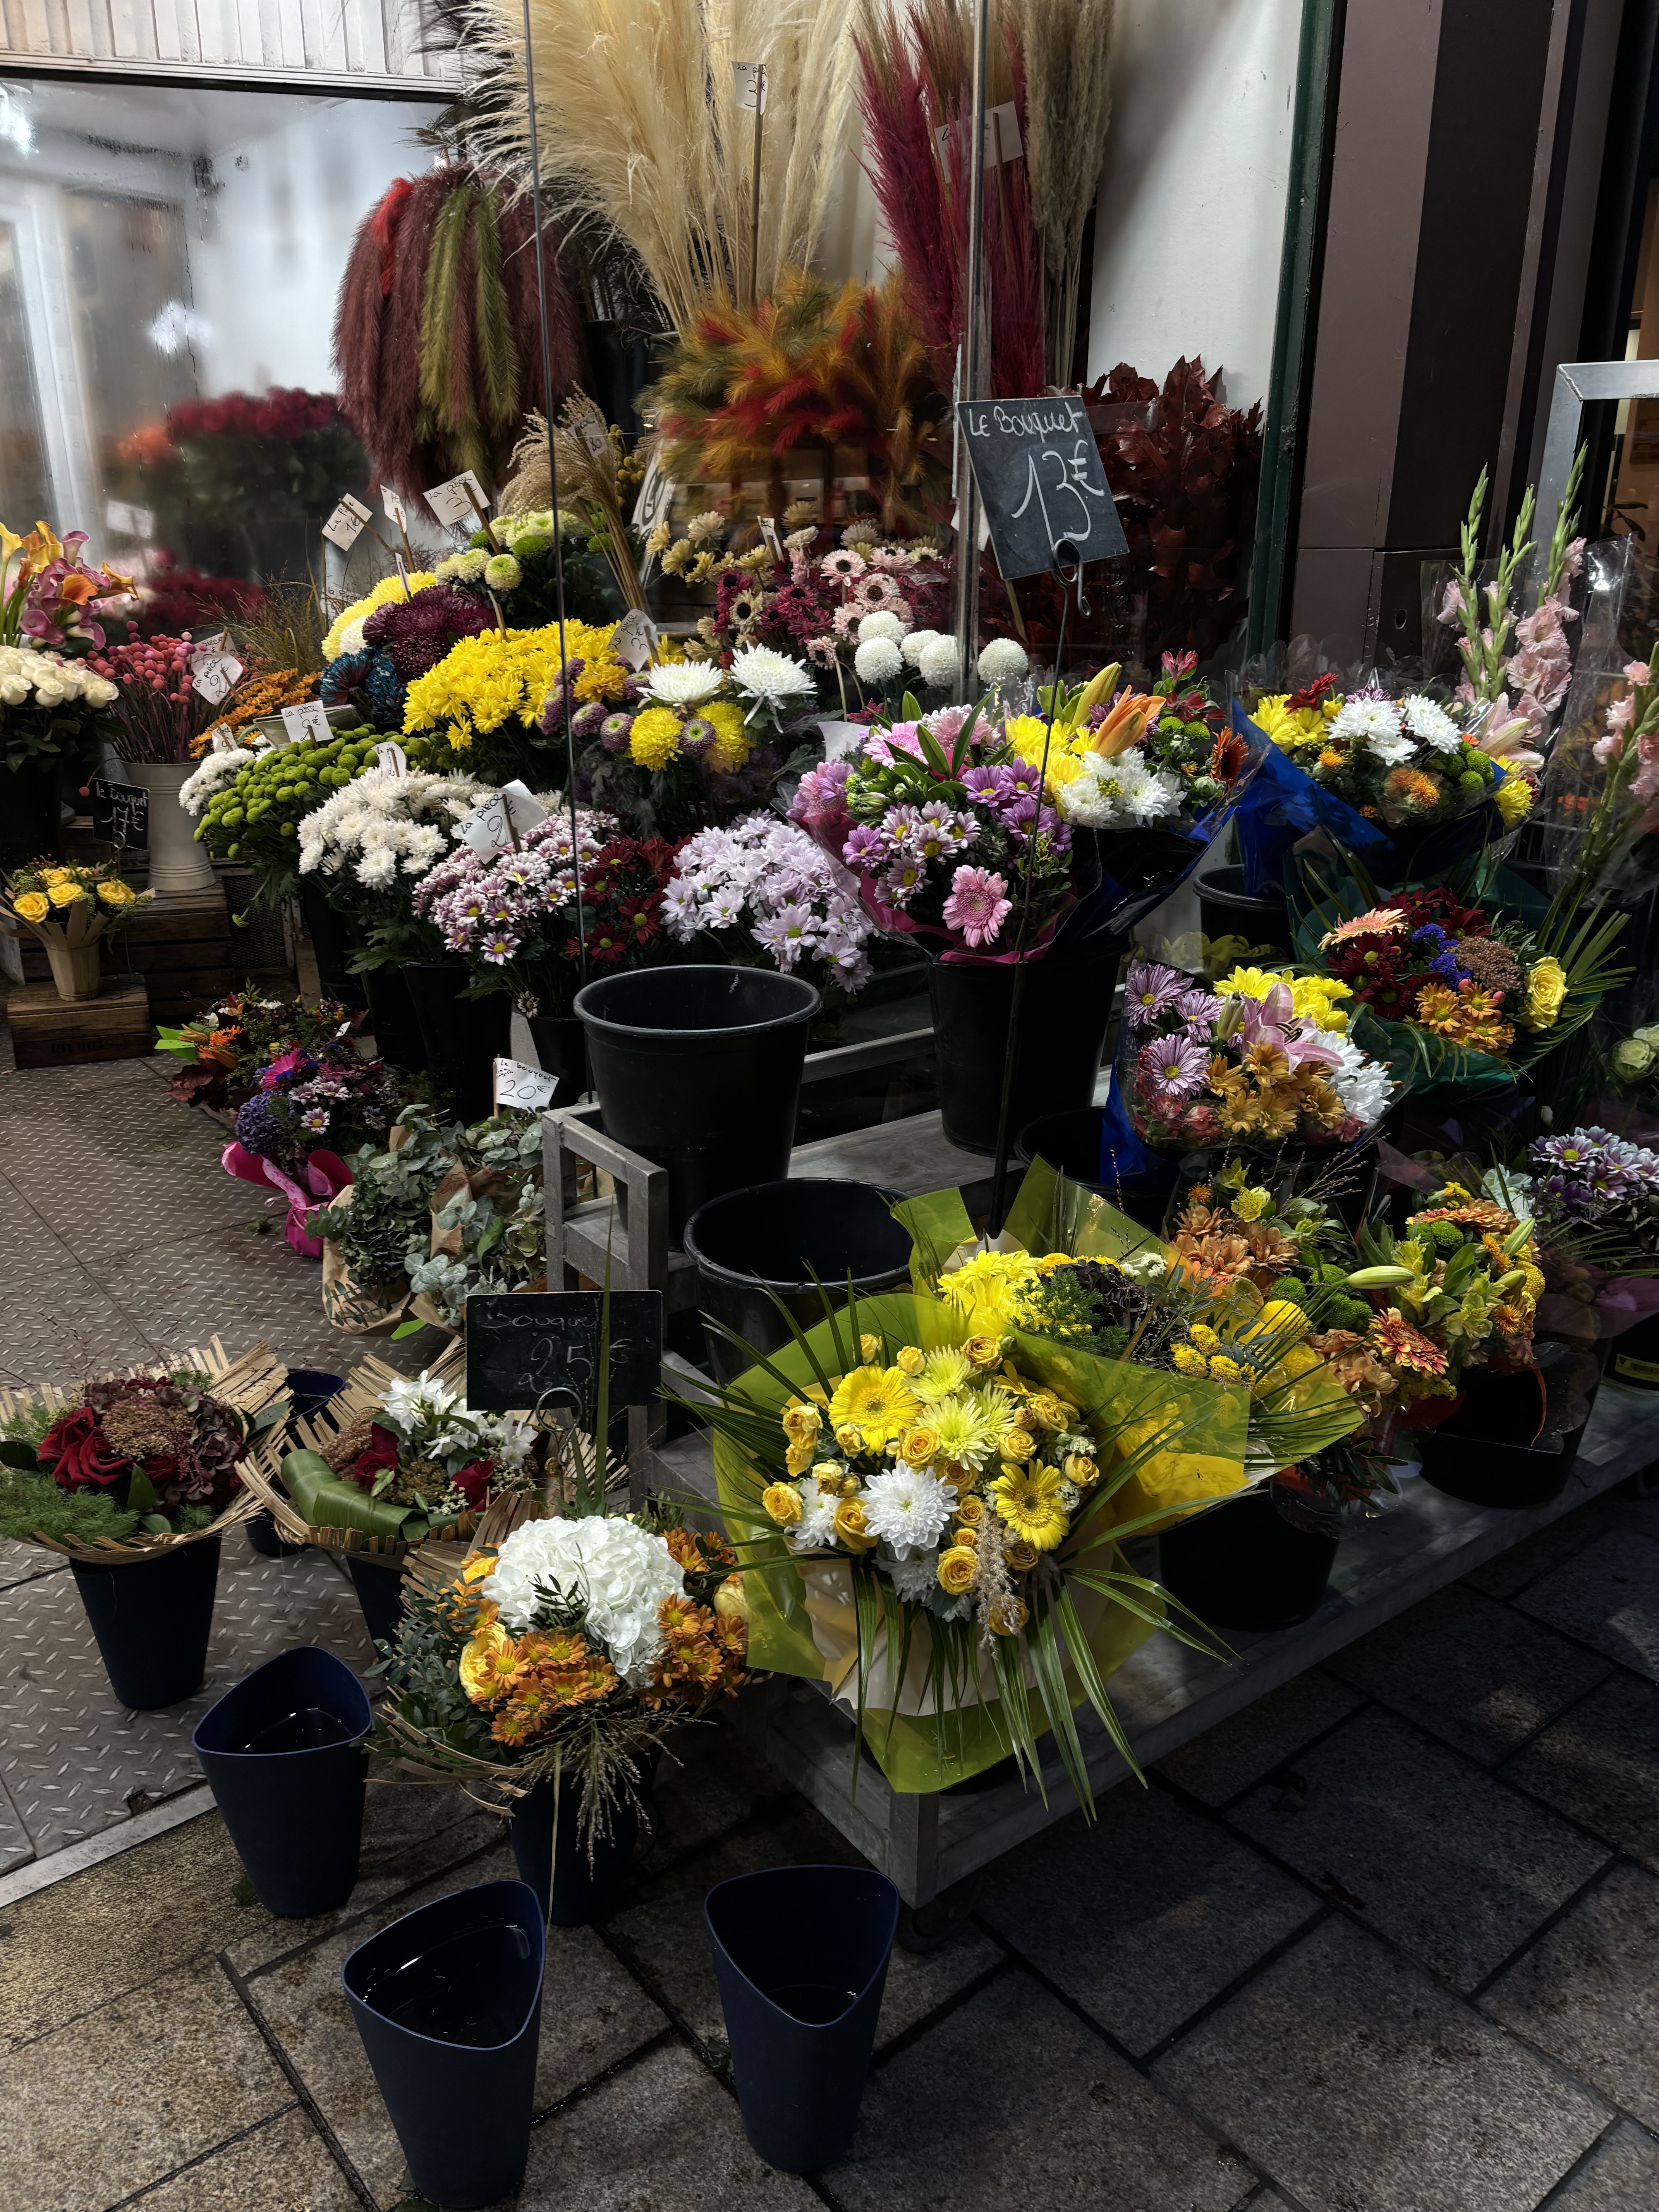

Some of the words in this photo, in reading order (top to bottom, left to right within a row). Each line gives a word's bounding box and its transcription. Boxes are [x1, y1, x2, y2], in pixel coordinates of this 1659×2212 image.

[993, 402, 1082, 443] Bouquet
[428, 492, 442, 500] La
[1011, 440, 1104, 551] 13€
[326, 519, 341, 531] La
[100, 807, 145, 835] 17€
[459, 822, 474, 835] La
[517, 1062, 557, 1082] bouquet
[500, 1079, 550, 1099] 20€
